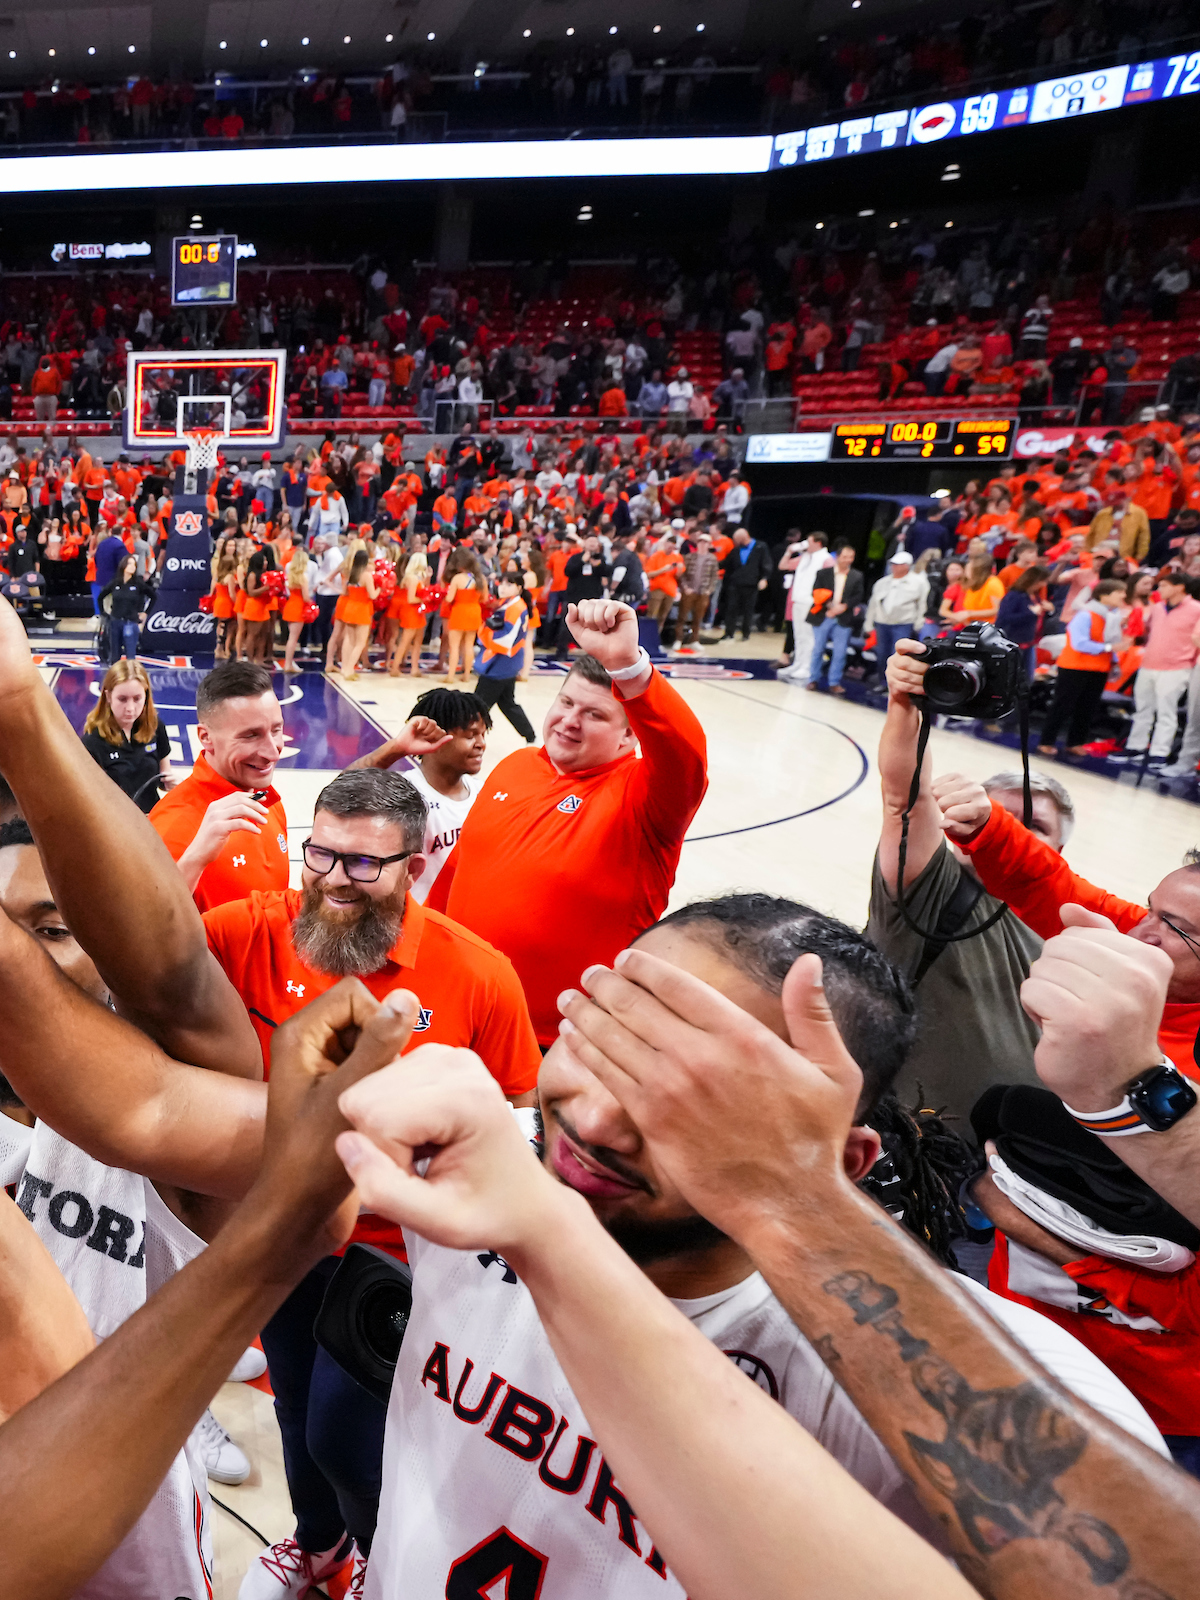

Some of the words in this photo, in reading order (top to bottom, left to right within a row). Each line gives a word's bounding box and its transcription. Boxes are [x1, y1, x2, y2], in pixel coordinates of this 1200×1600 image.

[1162, 50, 1200, 98] 72
[960, 92, 999, 135] 59
[891, 422, 938, 442] 00.0
[844, 438, 868, 456] 72
[921, 443, 934, 457] 2
[977, 435, 1006, 454] 59
[181, 558, 207, 571] PNC
[147, 611, 214, 634] Coca-Cola
